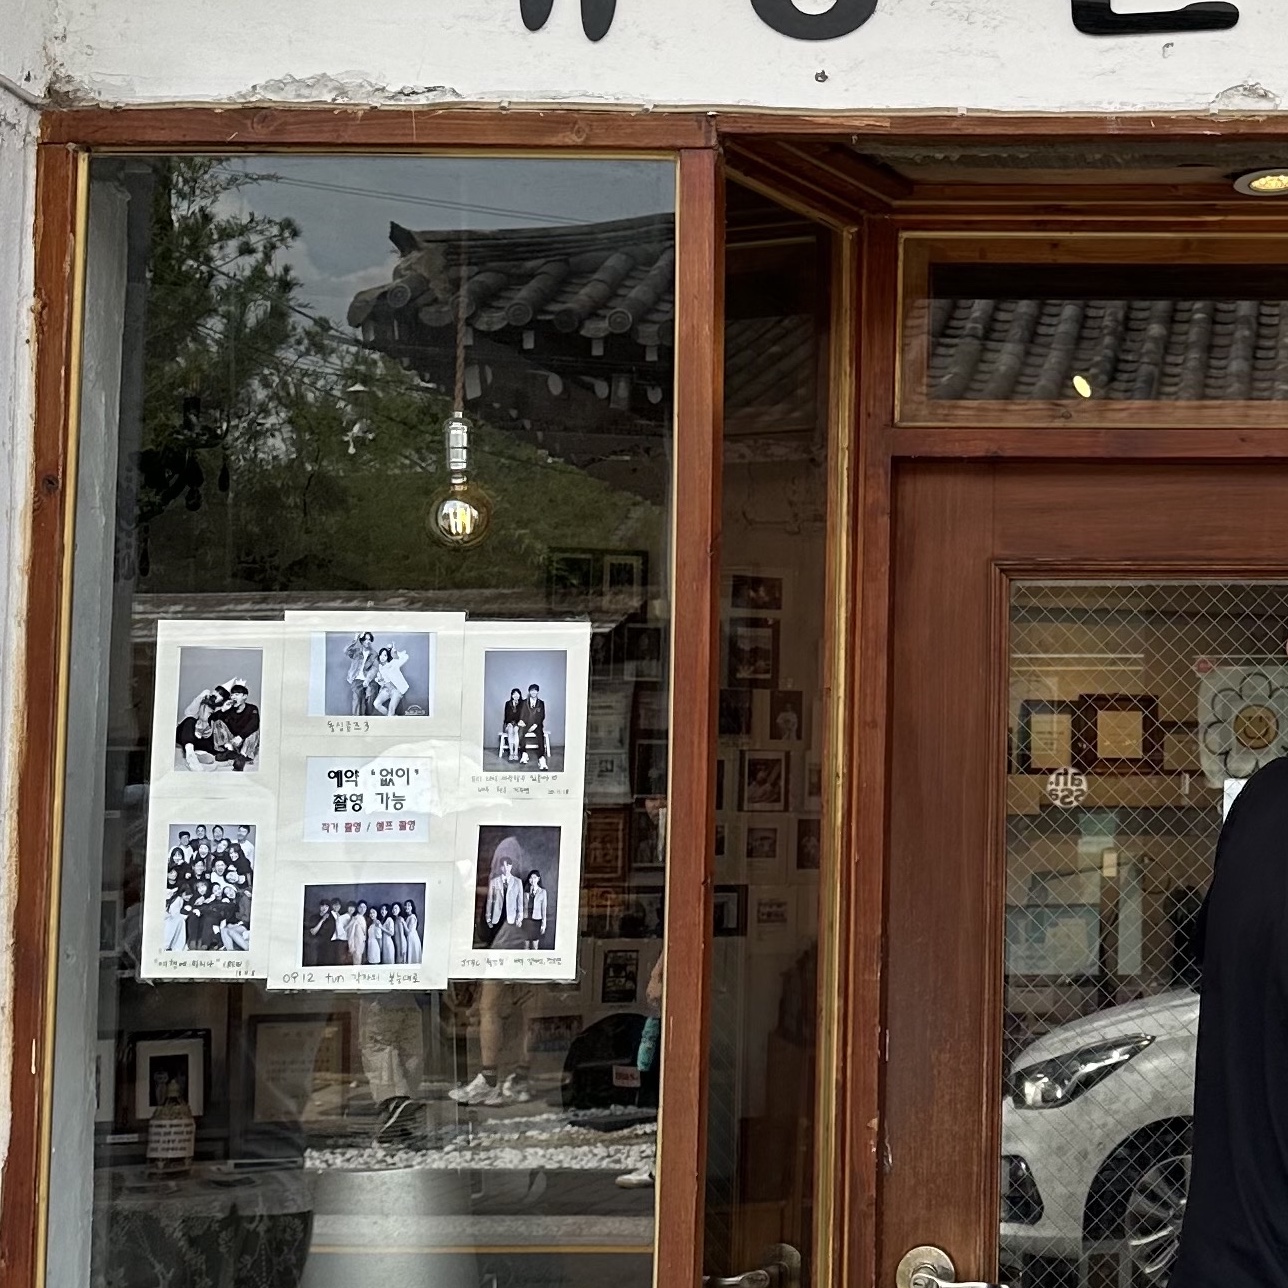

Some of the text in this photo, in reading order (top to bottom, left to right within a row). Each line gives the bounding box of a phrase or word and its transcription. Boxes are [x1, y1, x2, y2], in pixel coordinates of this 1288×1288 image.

[328, 769, 360, 788] 예약
[333, 792, 407, 812] 촬영 가능
[321, 822, 339, 833] 작가
[344, 821, 362, 833] 촬영
[375, 820, 394, 832] 셀프
[398, 819, 416, 831] 촬영
[388, 971, 421, 986] 본능대로
